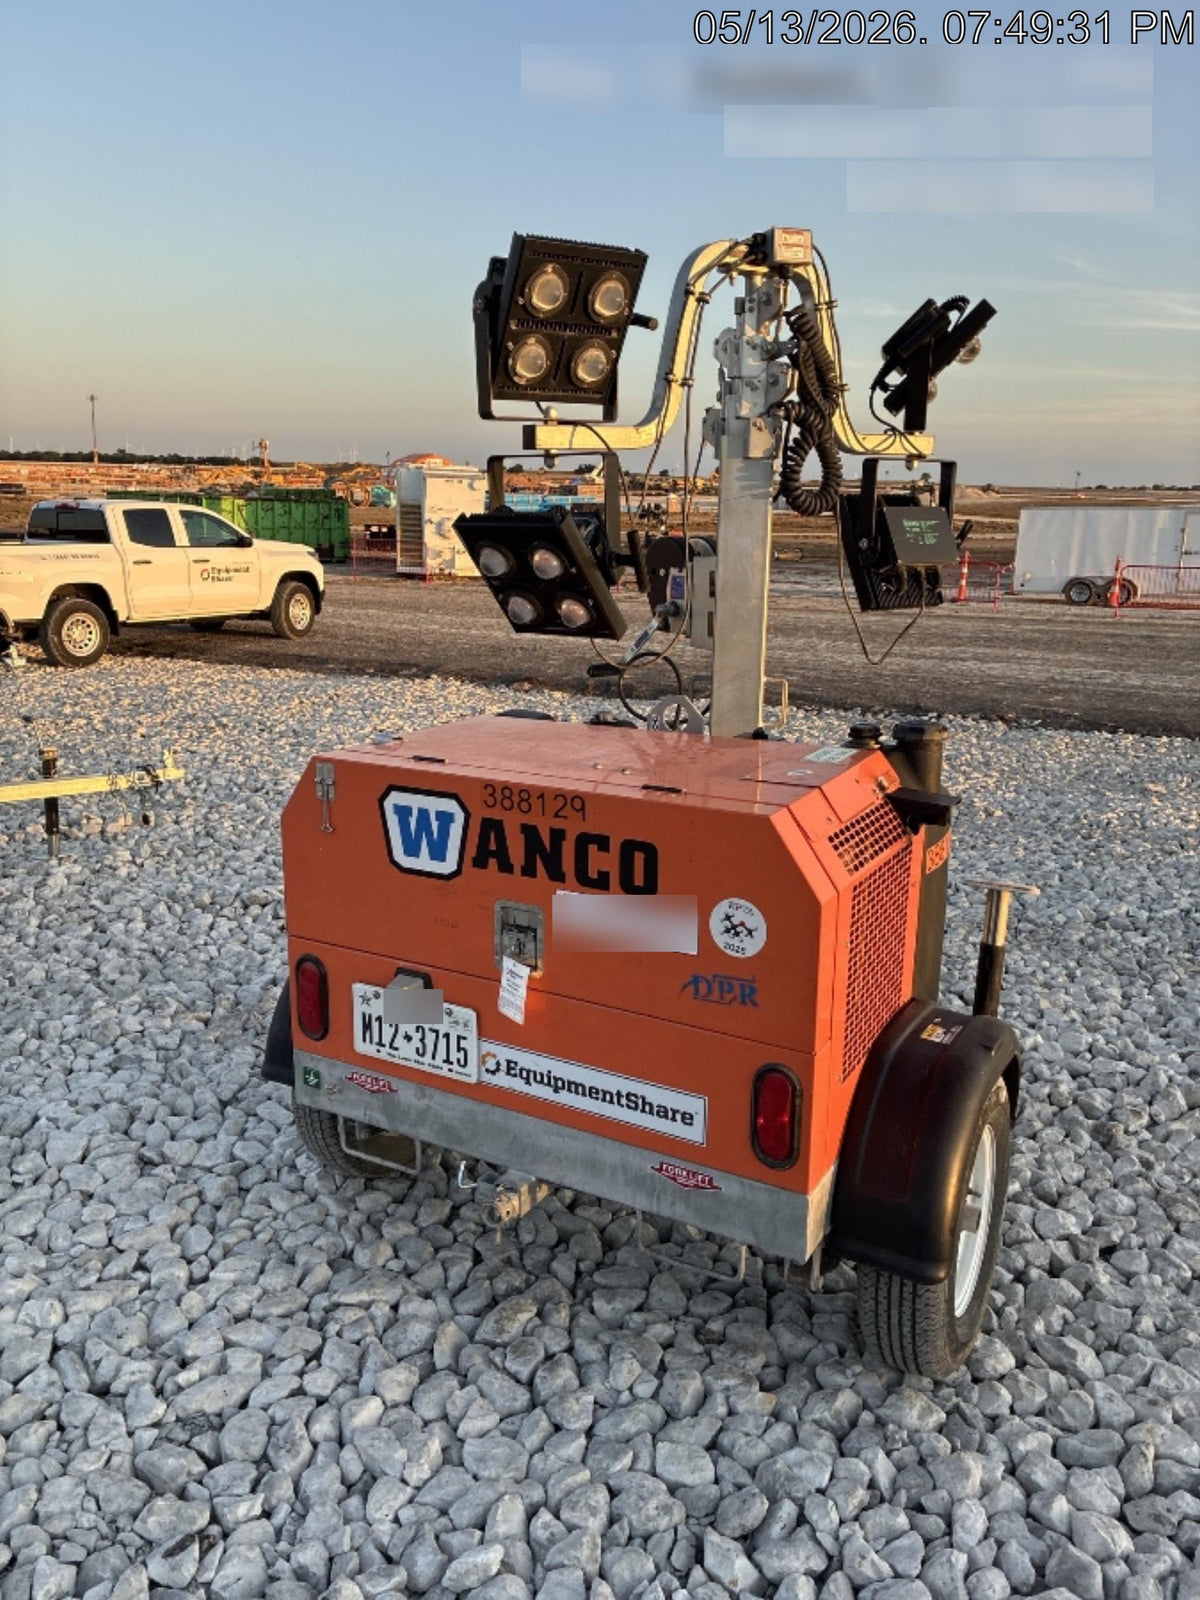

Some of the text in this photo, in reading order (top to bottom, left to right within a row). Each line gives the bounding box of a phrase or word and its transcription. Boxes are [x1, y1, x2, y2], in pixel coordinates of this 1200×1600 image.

[483, 783, 587, 822] 388129
[392, 802, 659, 895] WANCO
[680, 973, 759, 1008] DPR
[505, 1058, 695, 1127] EquipmentShare
